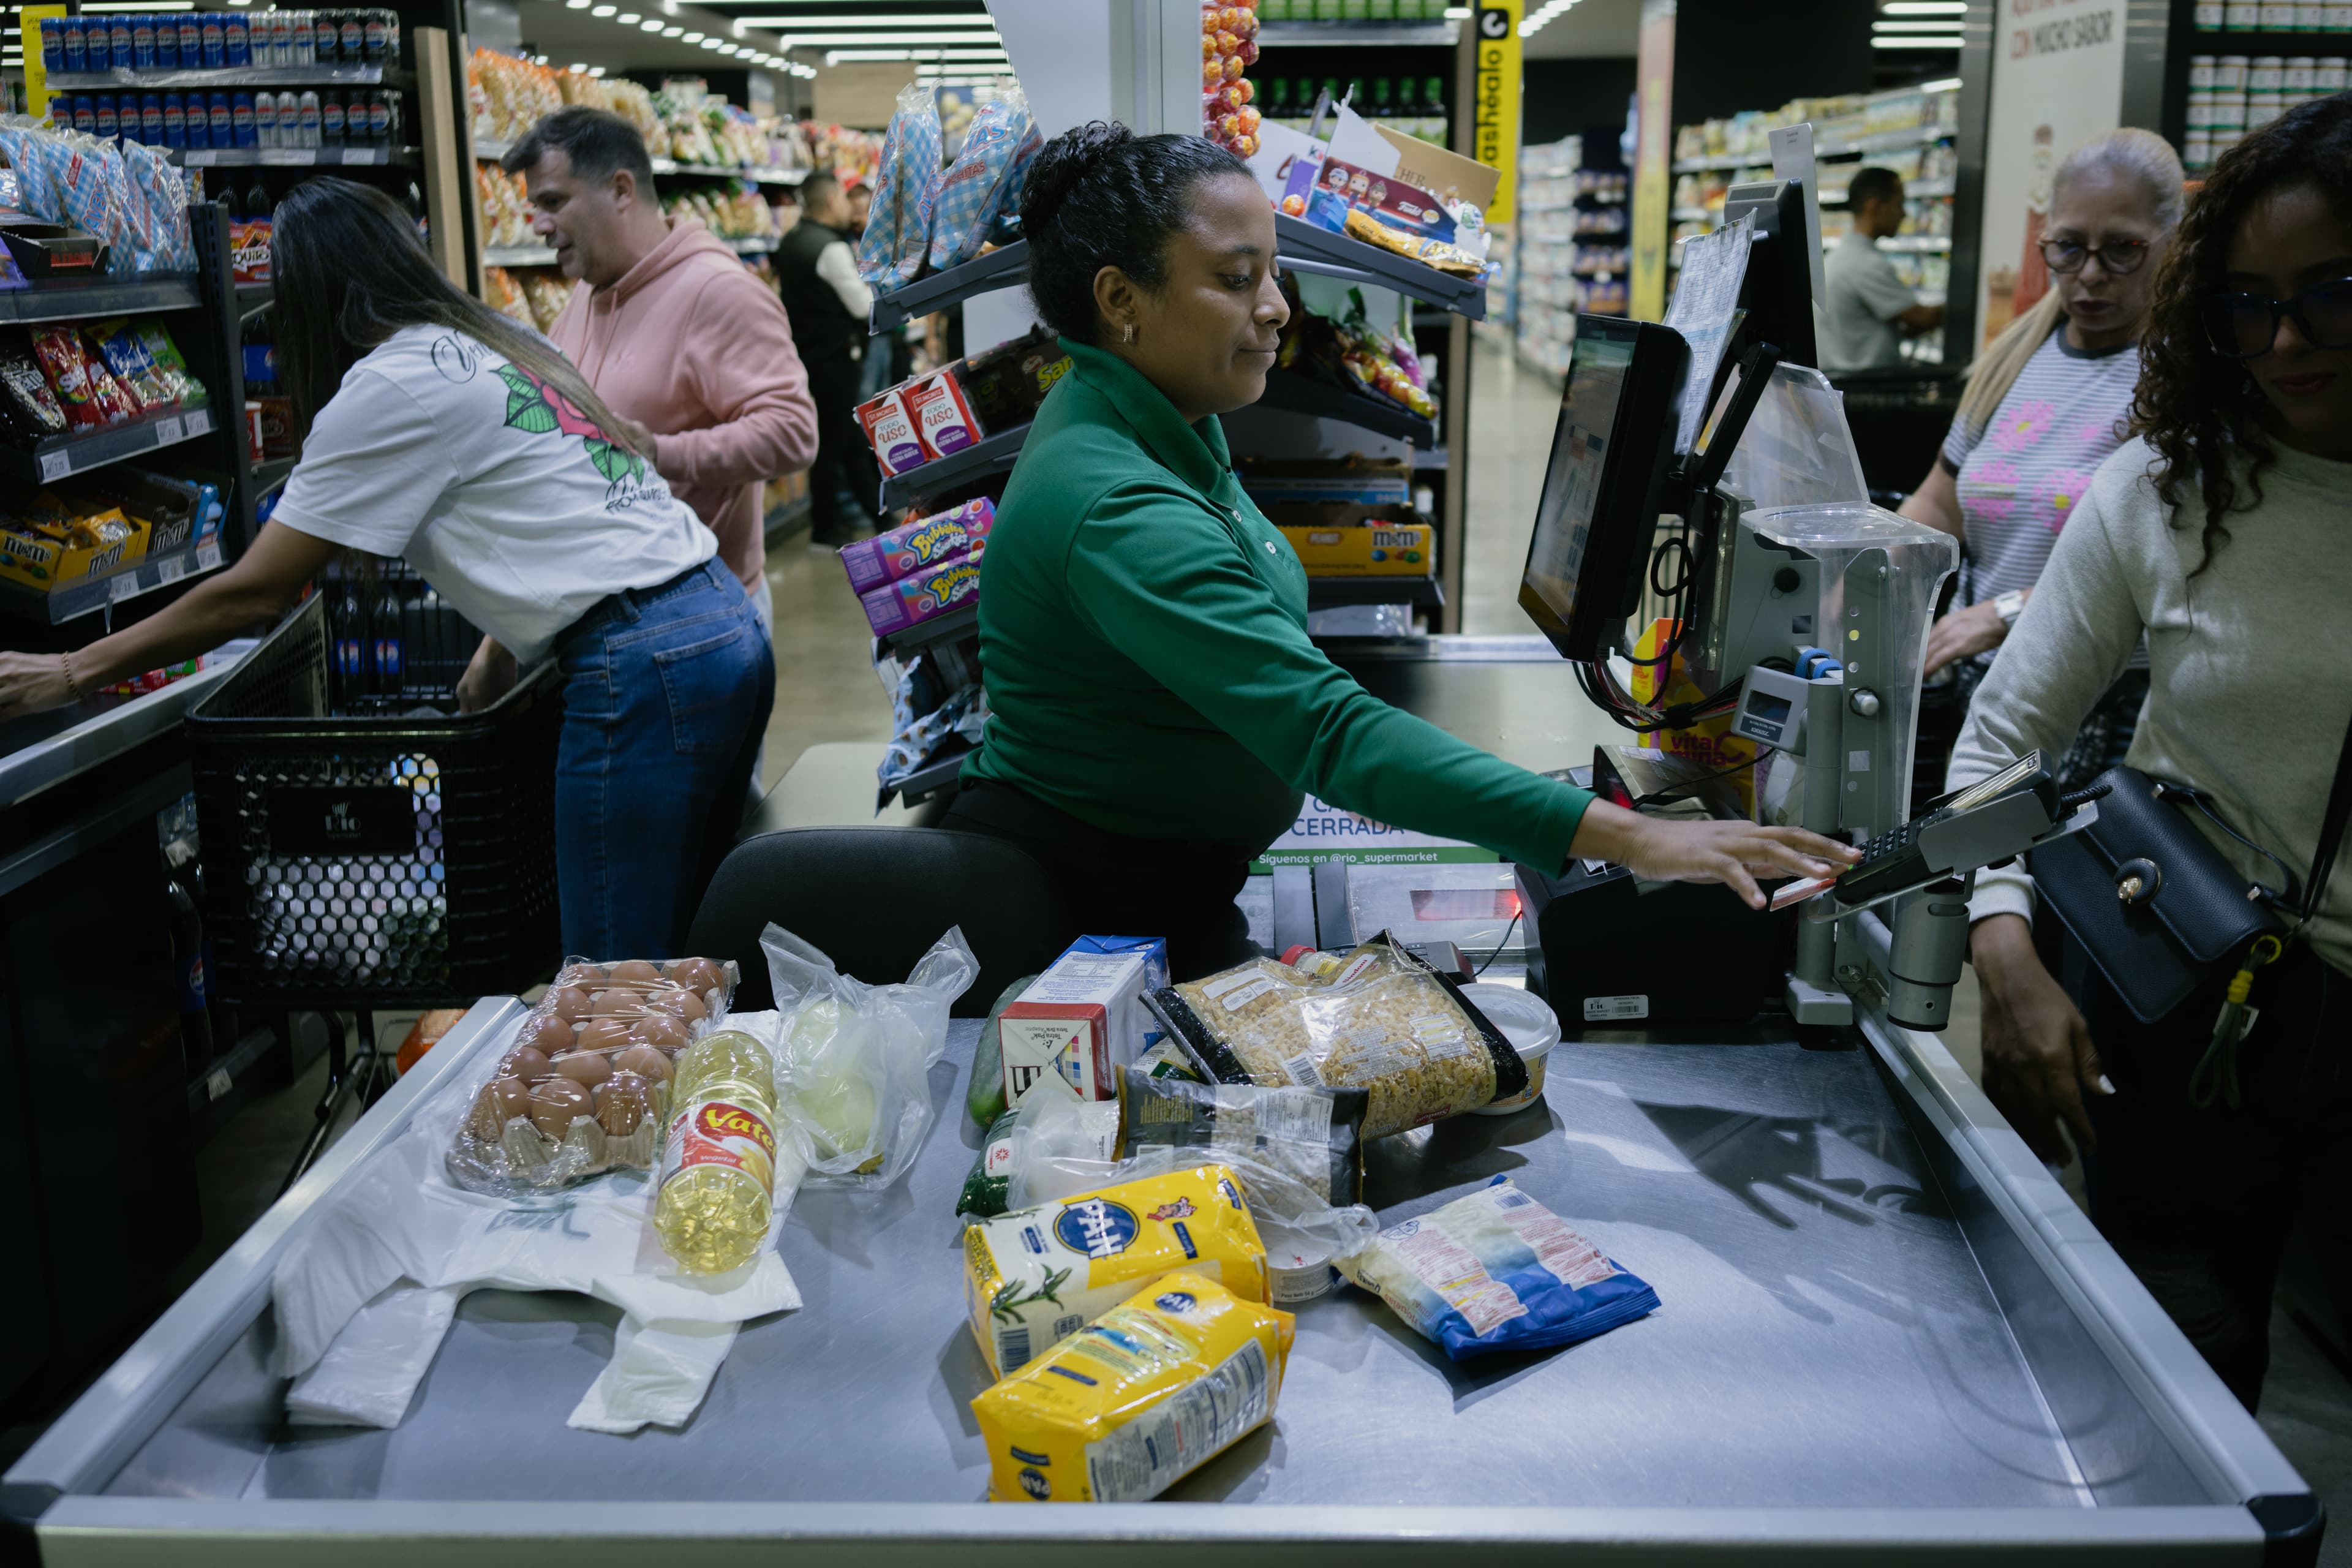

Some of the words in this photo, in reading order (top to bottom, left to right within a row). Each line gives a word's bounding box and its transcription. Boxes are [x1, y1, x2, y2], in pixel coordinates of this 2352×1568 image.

[926, 403, 945, 415] TODO
[880, 420, 899, 432] TODO
[1671, 731, 1712, 751] vita
[1259, 852, 1310, 865] Síguenos
[1313, 854, 1327, 863] en
[1330, 852, 1438, 865] @rio_supermarket
